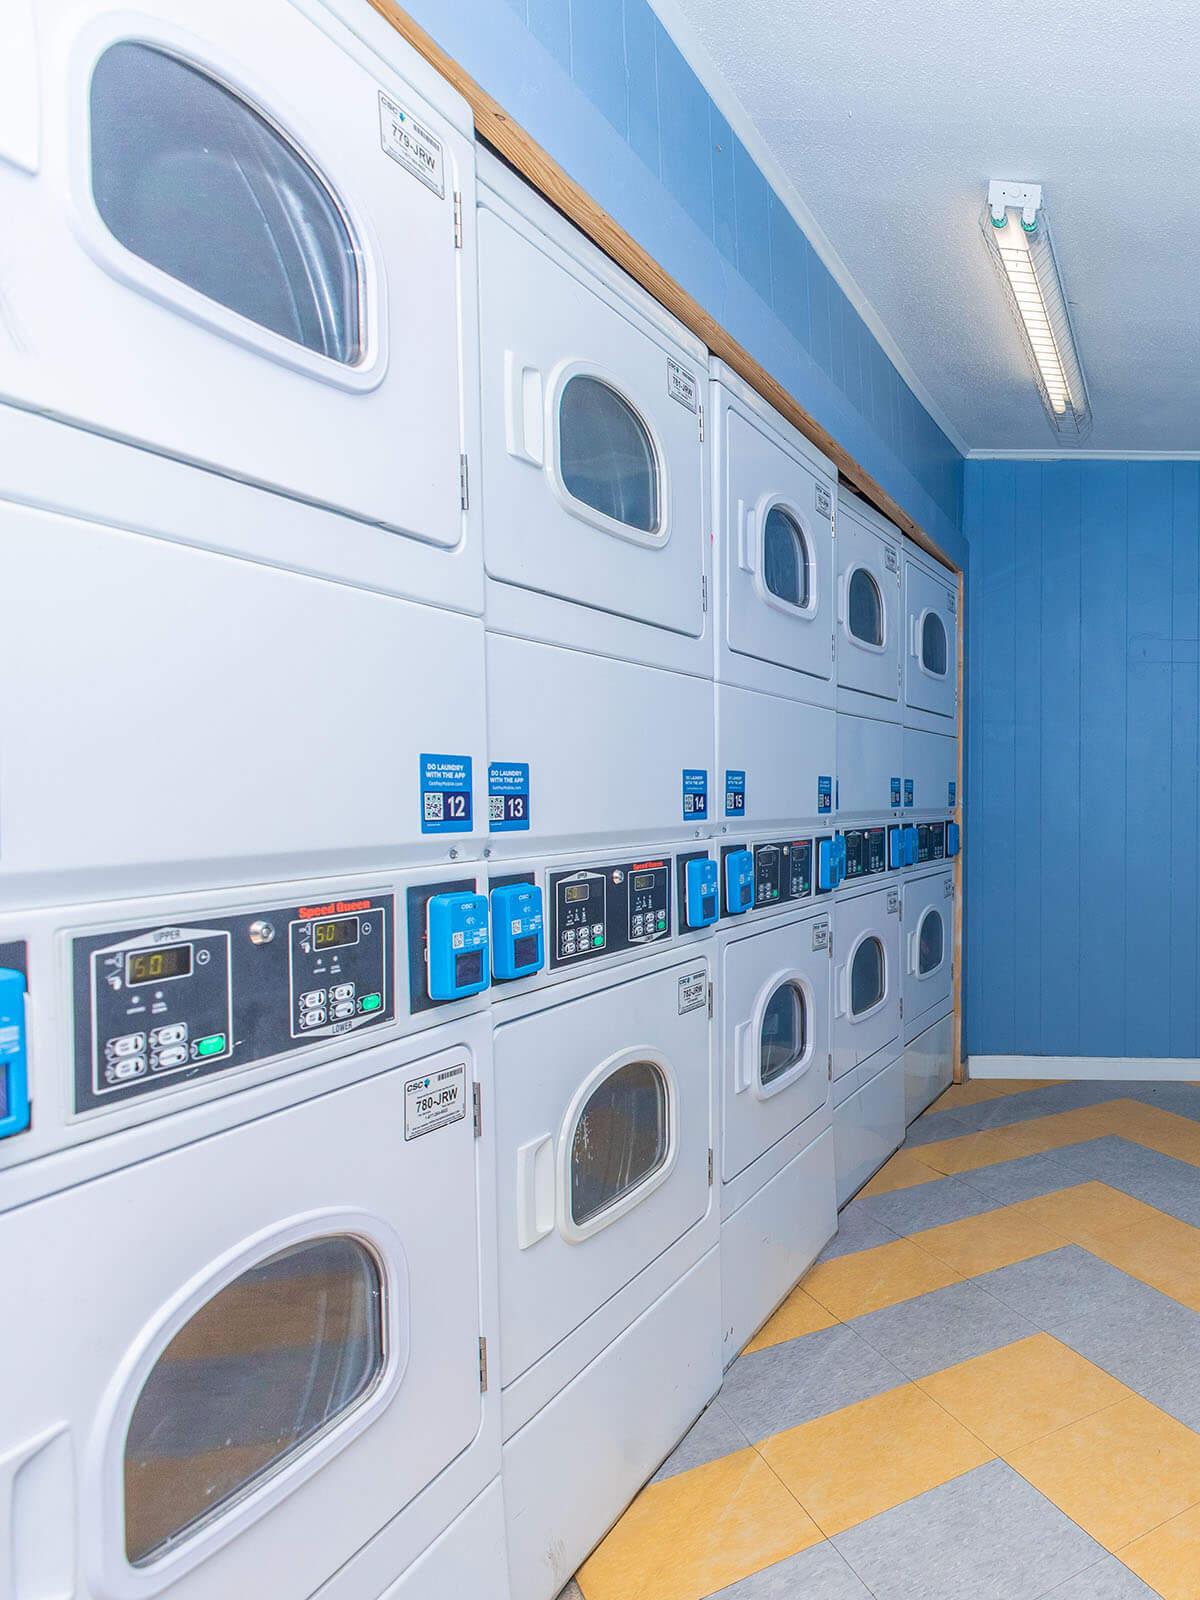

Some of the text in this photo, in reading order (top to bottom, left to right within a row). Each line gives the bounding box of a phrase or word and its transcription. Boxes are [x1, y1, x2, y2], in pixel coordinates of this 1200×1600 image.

[391, 123, 436, 169] 779-JRW
[438, 764, 464, 772] LAUNDRY
[454, 772, 466, 780] APP
[448, 796, 466, 817] 12
[508, 798, 524, 818] 13
[695, 796, 704, 810] 14
[735, 794, 742, 808] 15
[298, 900, 371, 919] Speed Queen
[153, 930, 180, 942] UPPER
[332, 1021, 352, 1034] LOWER
[407, 1081, 424, 1092] CSC
[416, 1087, 458, 1113] 780-JRW
